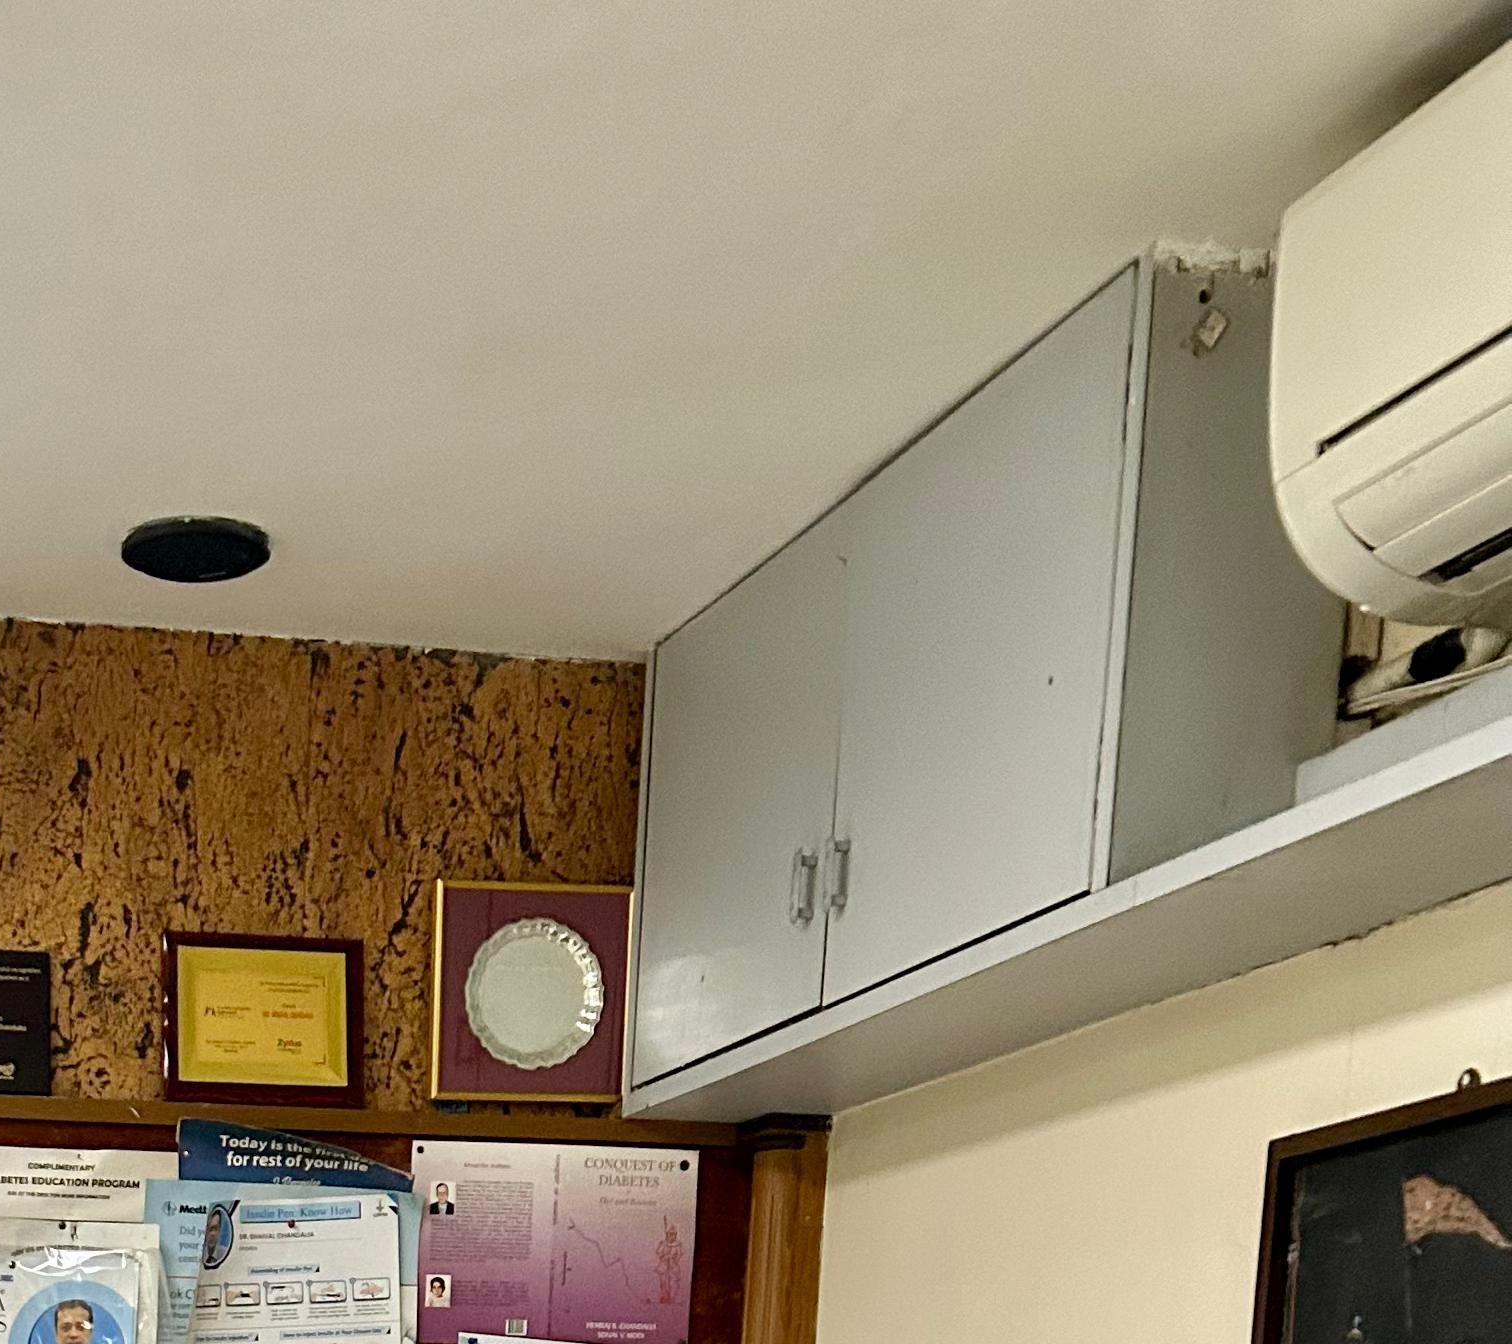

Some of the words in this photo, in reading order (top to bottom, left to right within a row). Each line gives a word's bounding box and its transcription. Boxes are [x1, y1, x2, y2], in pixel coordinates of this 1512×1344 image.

[219, 1134, 268, 1151] Today
[270, 1139, 283, 1151] is
[287, 1142, 312, 1154] the
[28, 1162, 95, 1172] COMPLIMENTARY
[226, 1151, 250, 1167] for
[253, 1154, 282, 1168] rest
[285, 1154, 301, 1168] of
[304, 1158, 340, 1171] your
[343, 1160, 369, 1172] life
[584, 1157, 656, 1172] CONQUEST
[658, 1160, 676, 1172] OF
[32, 1176, 88, 1187] EDUCATION
[92, 1179, 140, 1189] PROGRAM
[599, 1174, 660, 1187] DIABETES
[300, 1207, 327, 1217] Know
[330, 1206, 353, 1216] How
